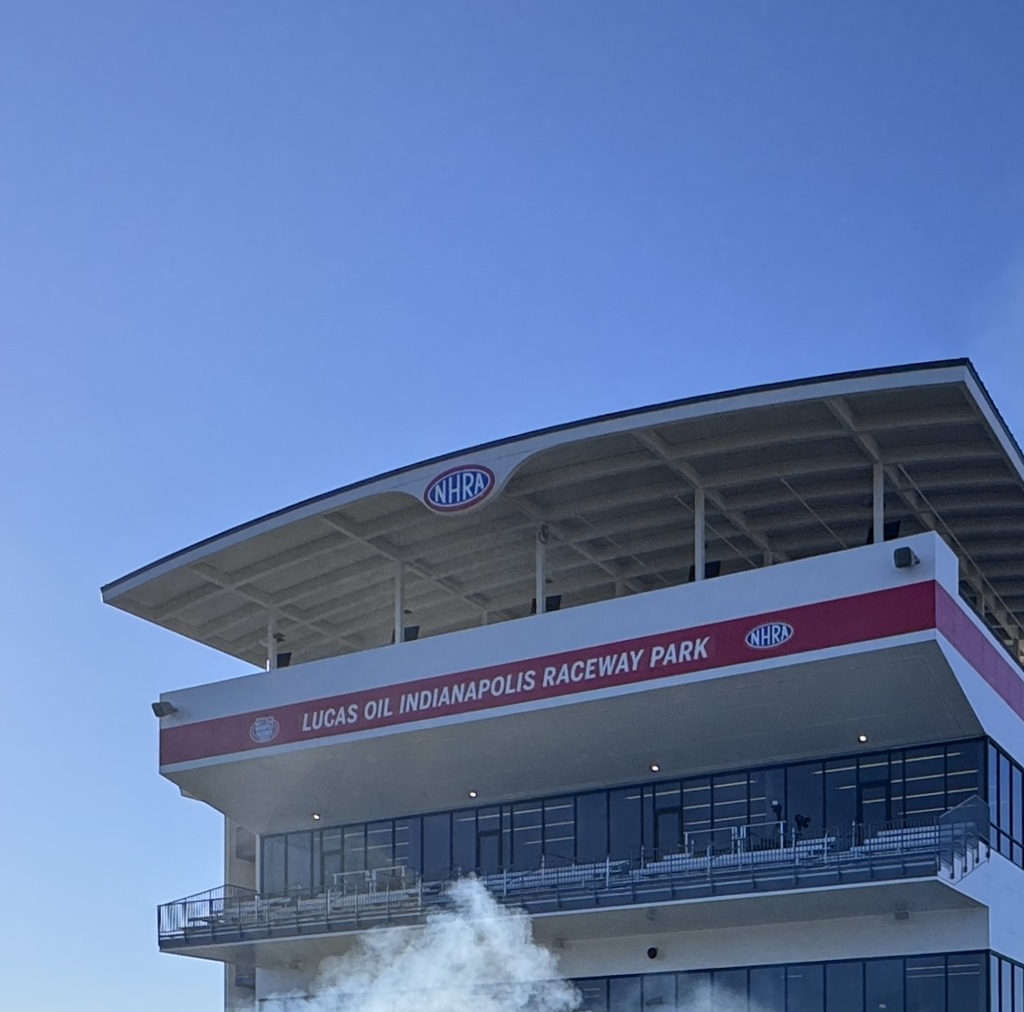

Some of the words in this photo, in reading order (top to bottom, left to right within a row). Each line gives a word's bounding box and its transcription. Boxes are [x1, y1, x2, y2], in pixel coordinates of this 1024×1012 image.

[435, 473, 484, 504] NHRA
[750, 626, 790, 647] NHRA
[302, 704, 358, 732] LUCAS
[364, 698, 392, 720] OIL
[399, 670, 537, 714] INDIANAPOLIS
[542, 649, 645, 687] RACEWAY
[650, 637, 710, 668] PARK
